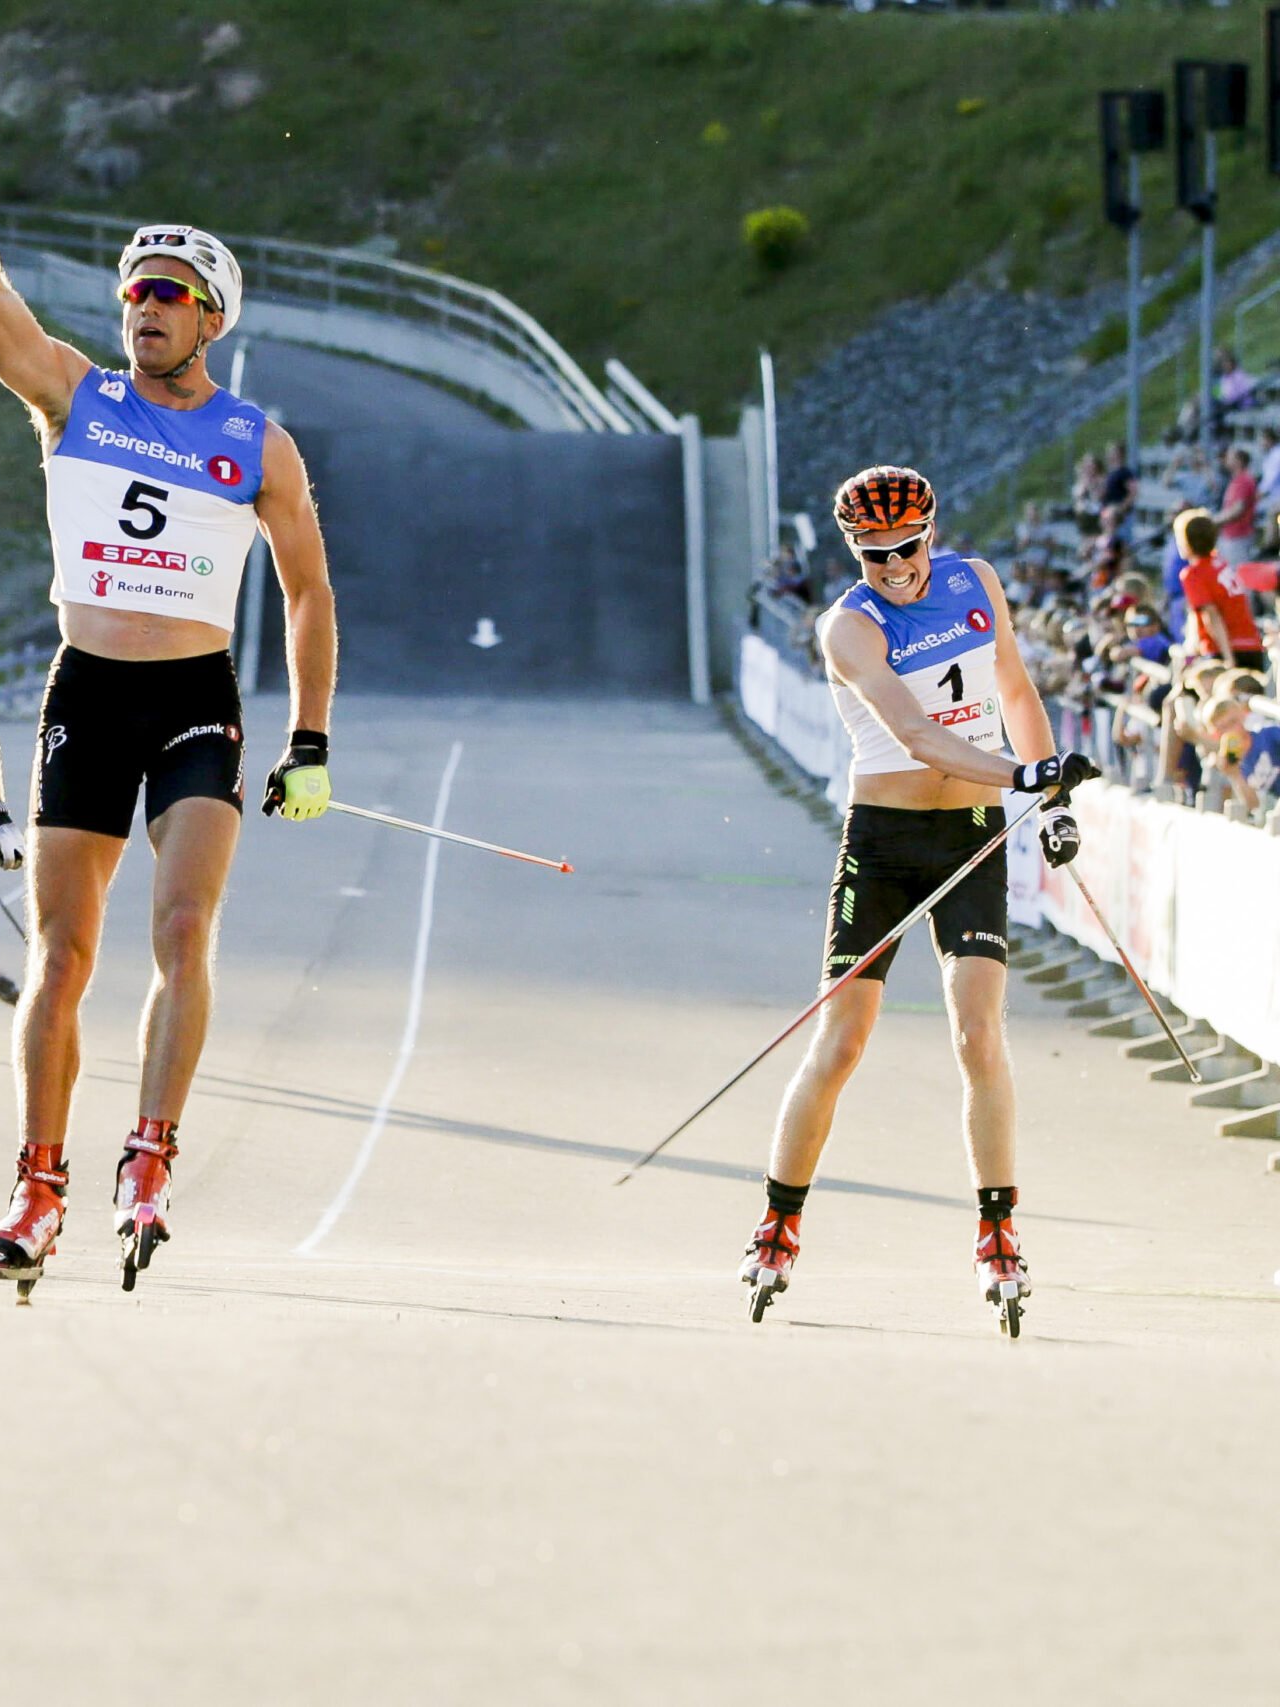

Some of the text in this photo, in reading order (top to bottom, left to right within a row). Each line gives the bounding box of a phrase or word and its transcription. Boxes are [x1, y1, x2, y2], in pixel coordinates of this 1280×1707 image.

[86, 421, 231, 480] SpareBank 1
[118, 480, 169, 540] 5
[102, 546, 185, 569] SPAR
[117, 581, 194, 600] Redd Barna
[972, 612, 986, 628] 1
[937, 663, 964, 703] 1
[928, 705, 981, 726] PAR
[968, 731, 994, 744] Barna
